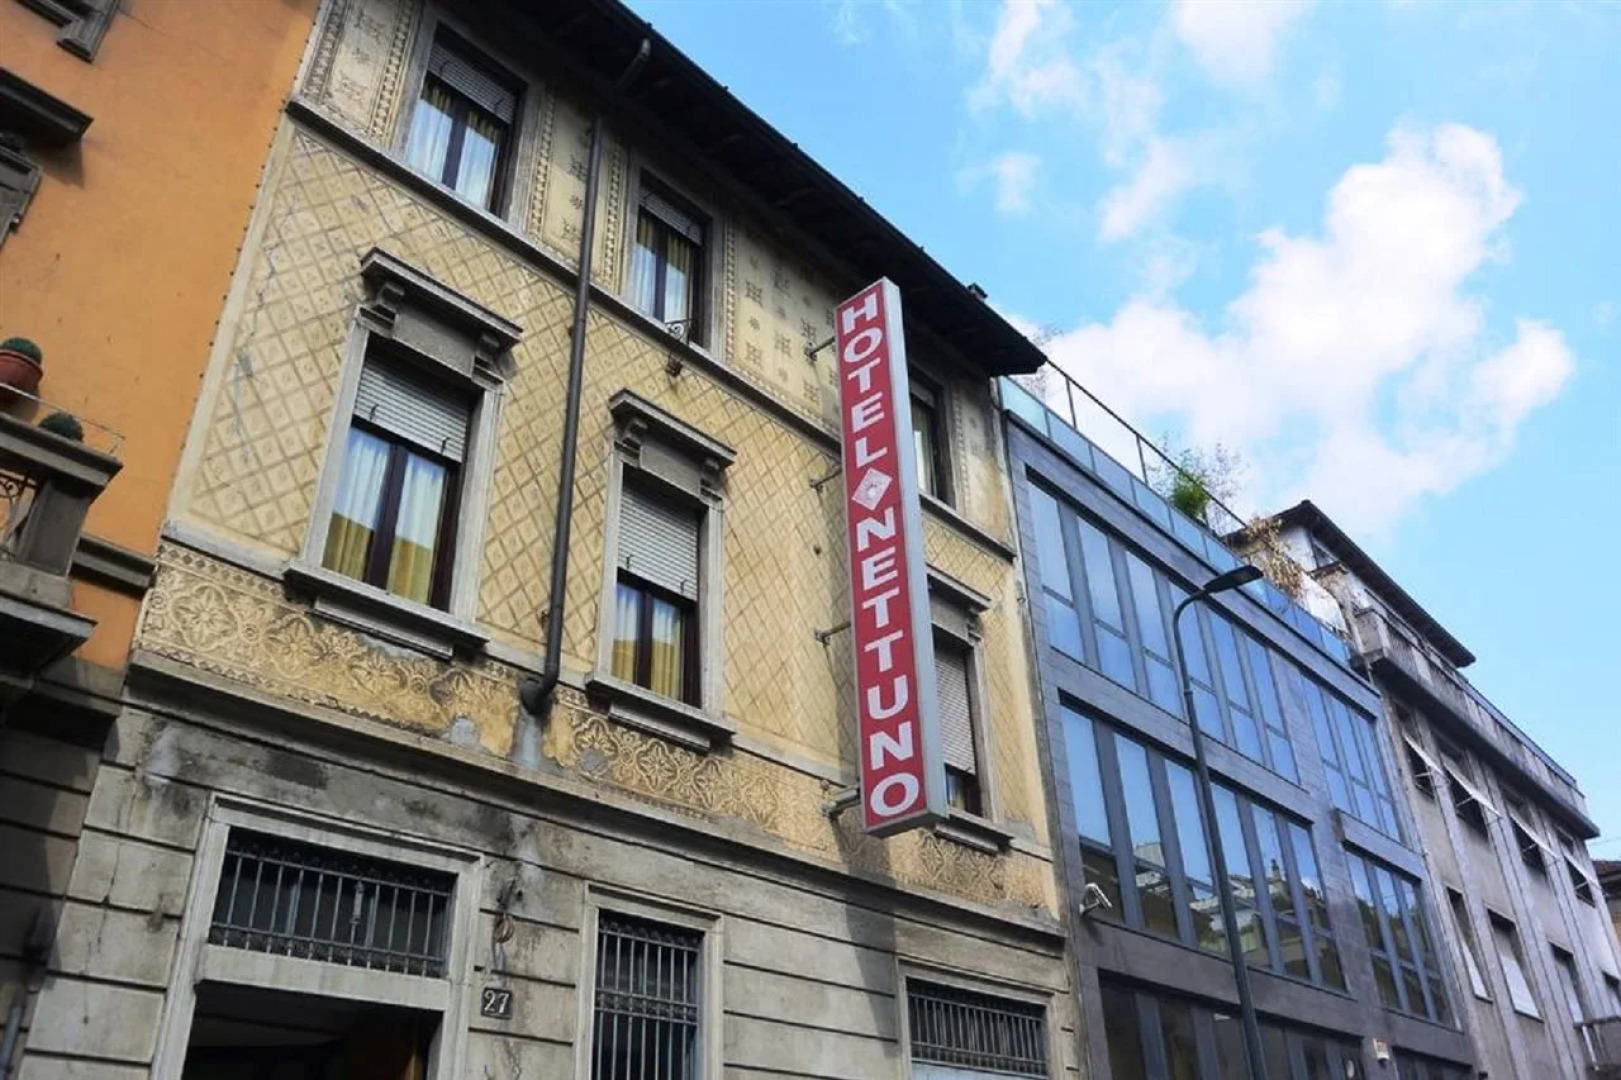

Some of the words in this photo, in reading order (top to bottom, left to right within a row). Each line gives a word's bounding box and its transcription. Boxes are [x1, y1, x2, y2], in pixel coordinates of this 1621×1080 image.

[842, 292, 888, 469] HOTEL
[856, 506, 920, 817] NETTUNO
[484, 989, 510, 1014] 27
